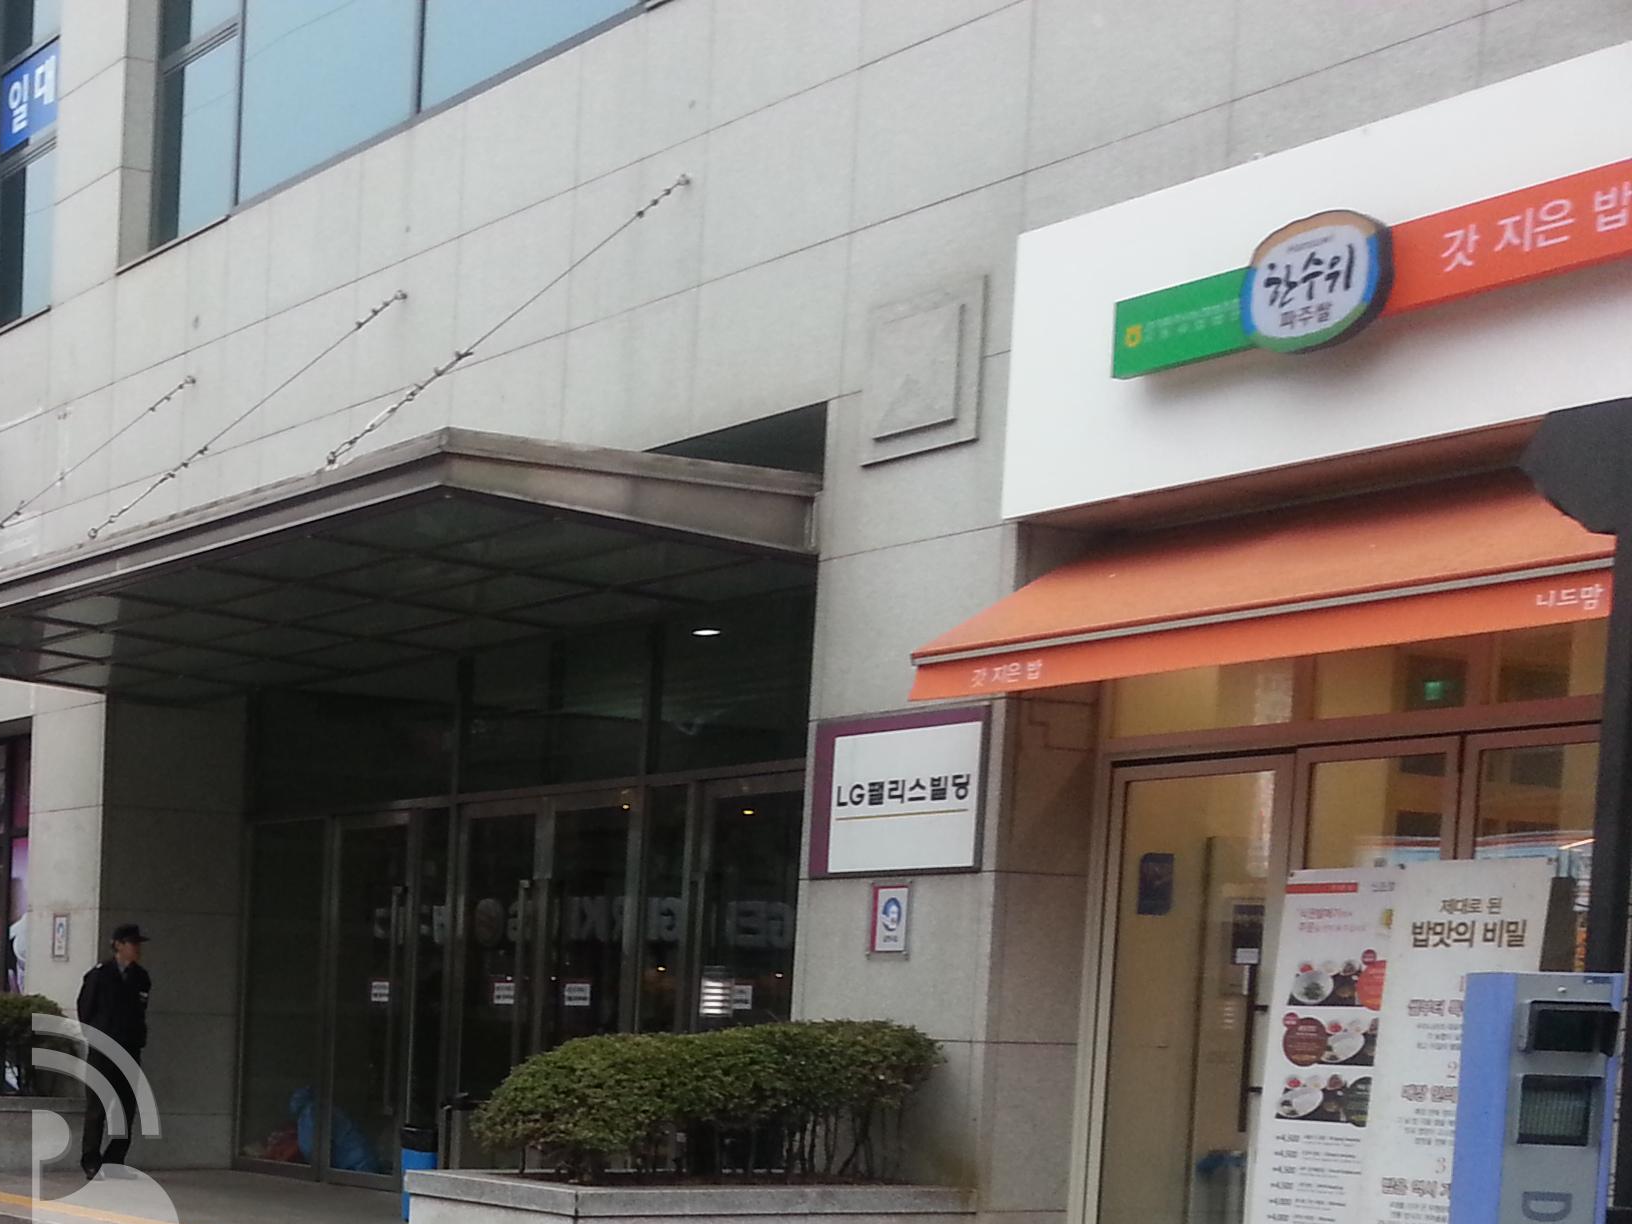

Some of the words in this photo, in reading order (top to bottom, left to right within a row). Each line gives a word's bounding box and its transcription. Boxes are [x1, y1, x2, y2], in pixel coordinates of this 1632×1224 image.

[1441, 223, 1480, 272] 갓
[1493, 198, 1575, 253] 지은
[1593, 180, 1632, 233] 밥
[1264, 243, 1356, 308] 한수위
[1280, 302, 1333, 329] 파주쌀
[1535, 583, 1606, 611] 니드맘
[970, 667, 987, 689] 갓
[991, 662, 1022, 684] 지은
[1026, 659, 1043, 681] 밥
[1439, 897, 1483, 914] 제대로
[1486, 897, 1503, 915] 된
[1411, 919, 1476, 948] 밥맛의
[1482, 919, 1527, 948] 비밀
